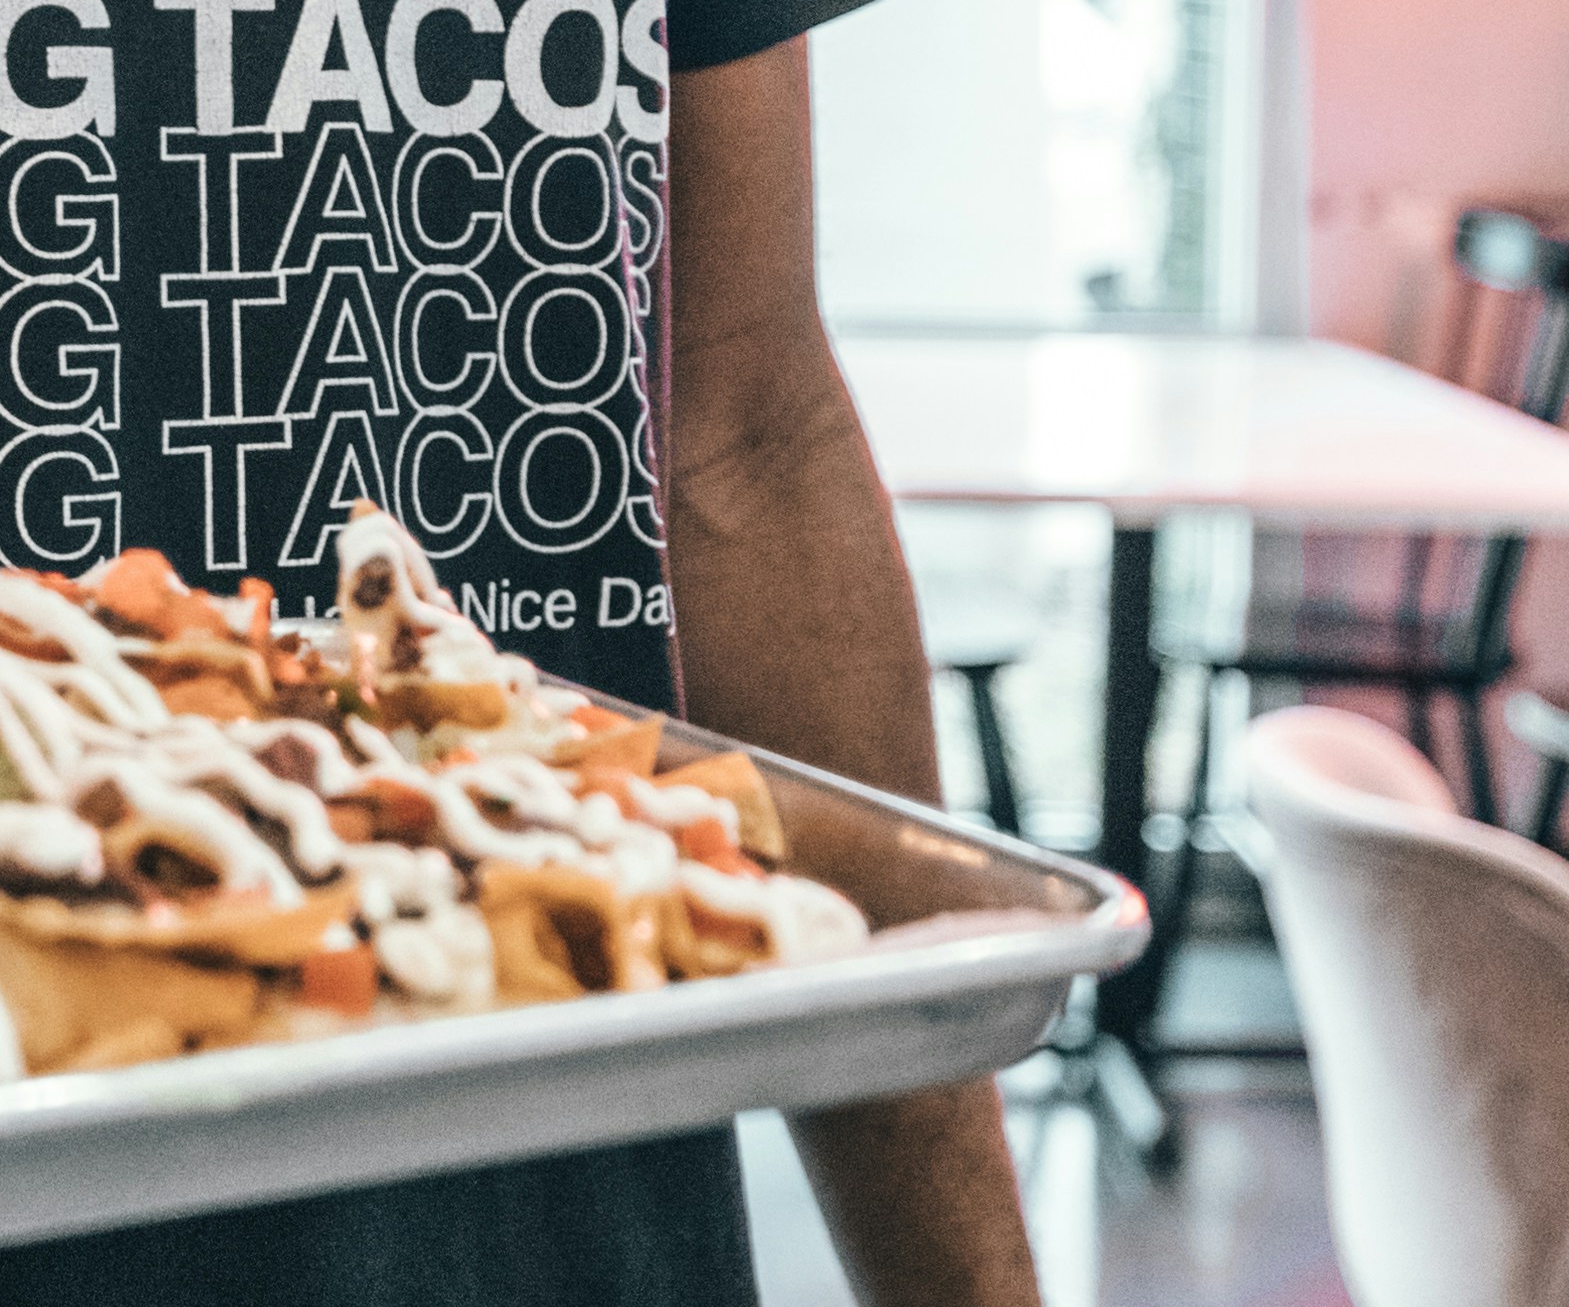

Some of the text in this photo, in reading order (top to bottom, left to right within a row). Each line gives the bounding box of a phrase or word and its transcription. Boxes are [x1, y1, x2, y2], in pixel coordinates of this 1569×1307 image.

[160, 122, 666, 275] TACOS
[460, 576, 678, 637] Nice Da
